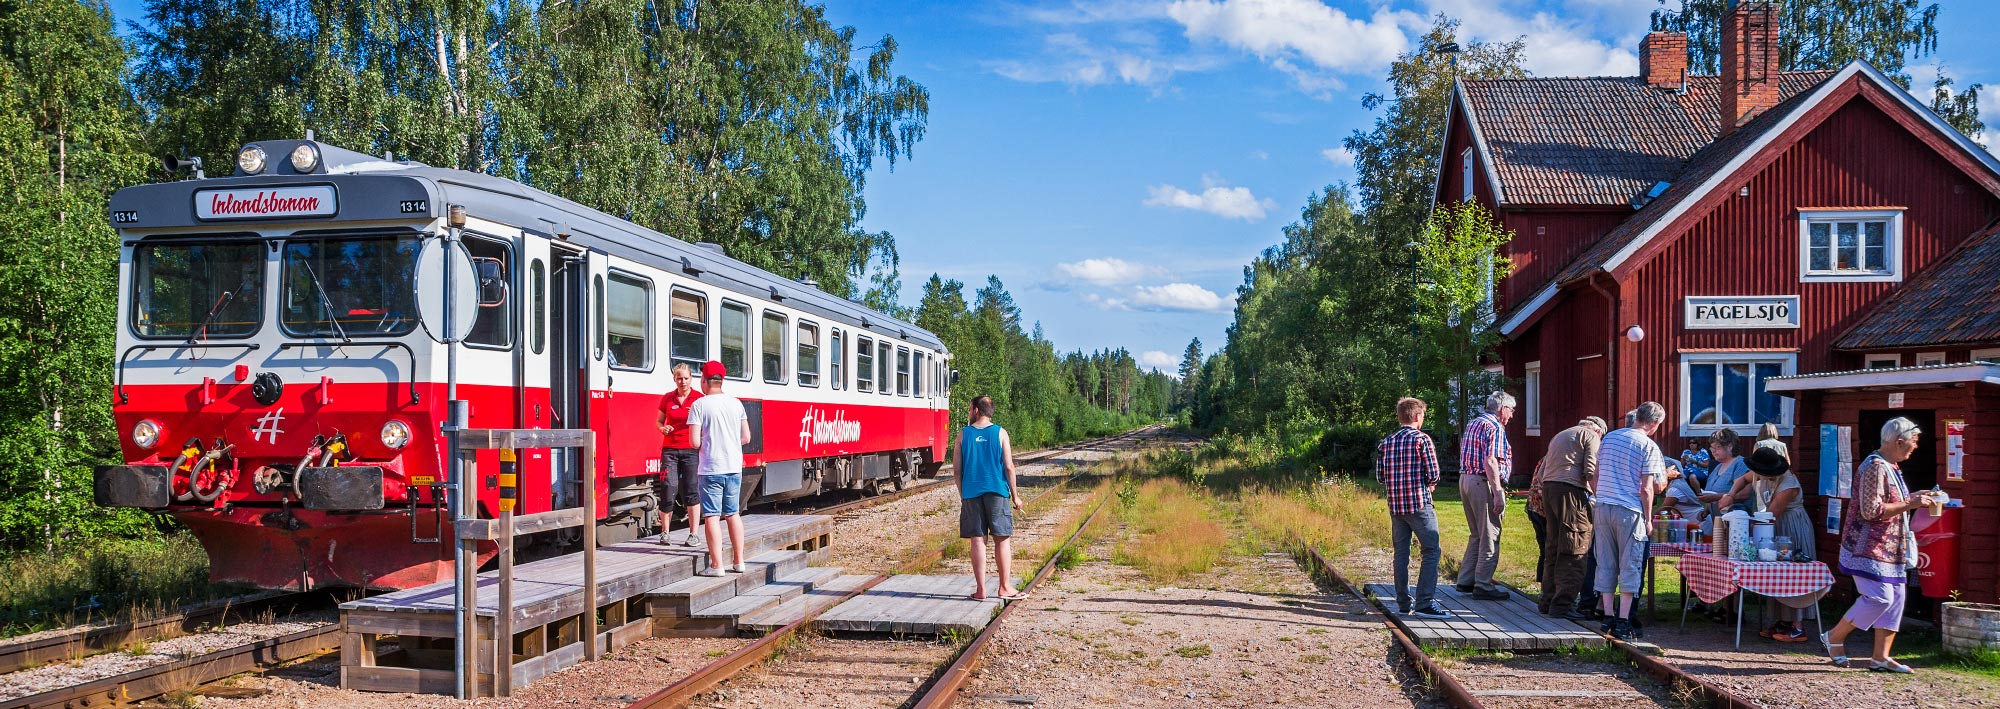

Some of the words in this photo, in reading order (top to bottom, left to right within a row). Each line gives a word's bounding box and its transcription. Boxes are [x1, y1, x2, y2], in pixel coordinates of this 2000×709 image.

[211, 191, 320, 215] Inlandsbanan
[400, 201, 426, 212] 1314
[114, 212, 138, 222] 1314
[1695, 301, 1789, 321] FÅGELSJÖ
